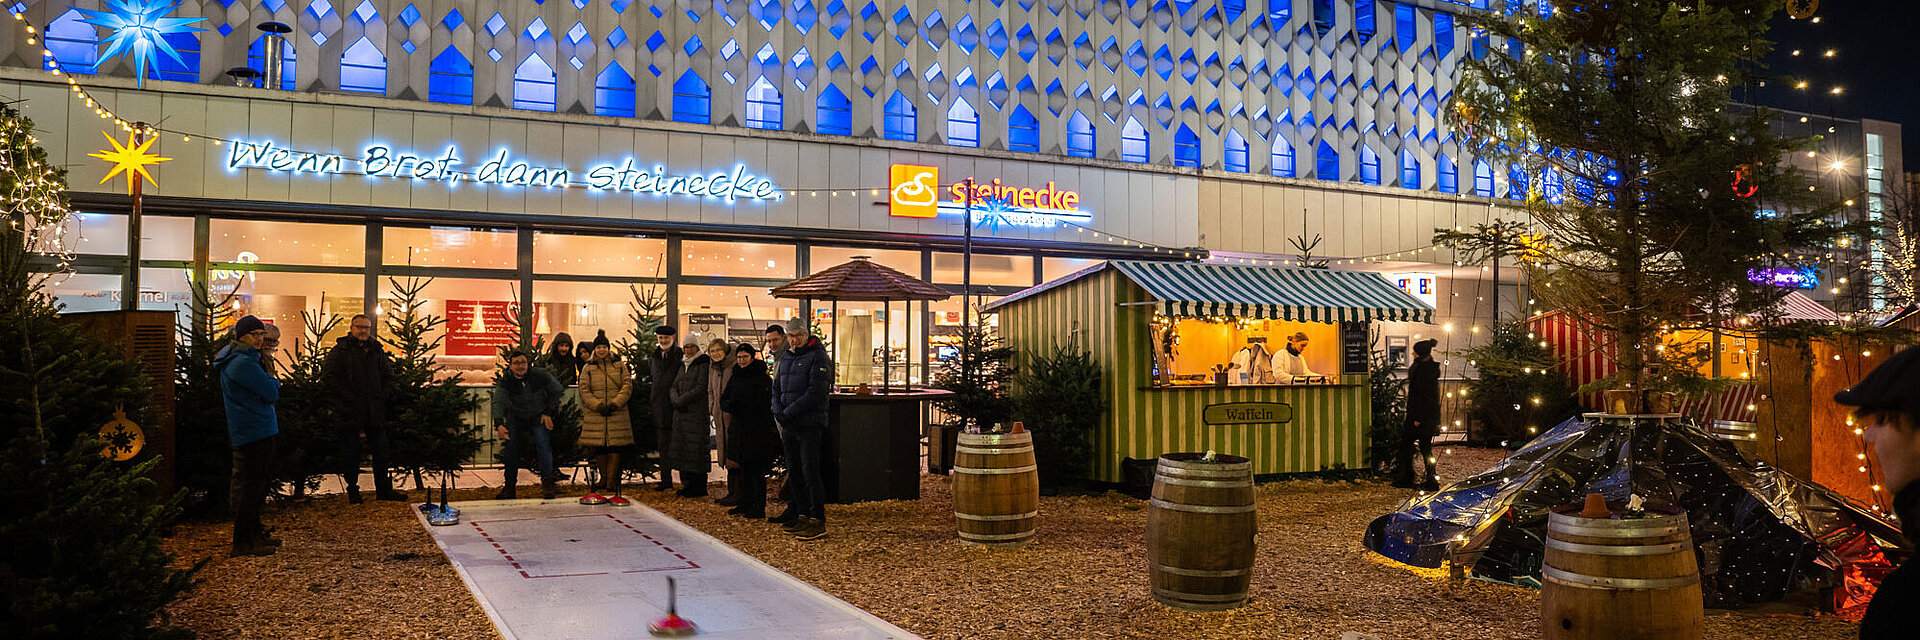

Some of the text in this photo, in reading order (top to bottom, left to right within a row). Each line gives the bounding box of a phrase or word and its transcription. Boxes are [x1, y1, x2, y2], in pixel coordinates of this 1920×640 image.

[230, 140, 341, 173] Wenn
[364, 145, 461, 182] Brot,
[478, 150, 569, 186] dann
[951, 176, 1080, 212] steinecke
[110, 290, 168, 303] Kmel
[1226, 407, 1274, 421] Waffeln
